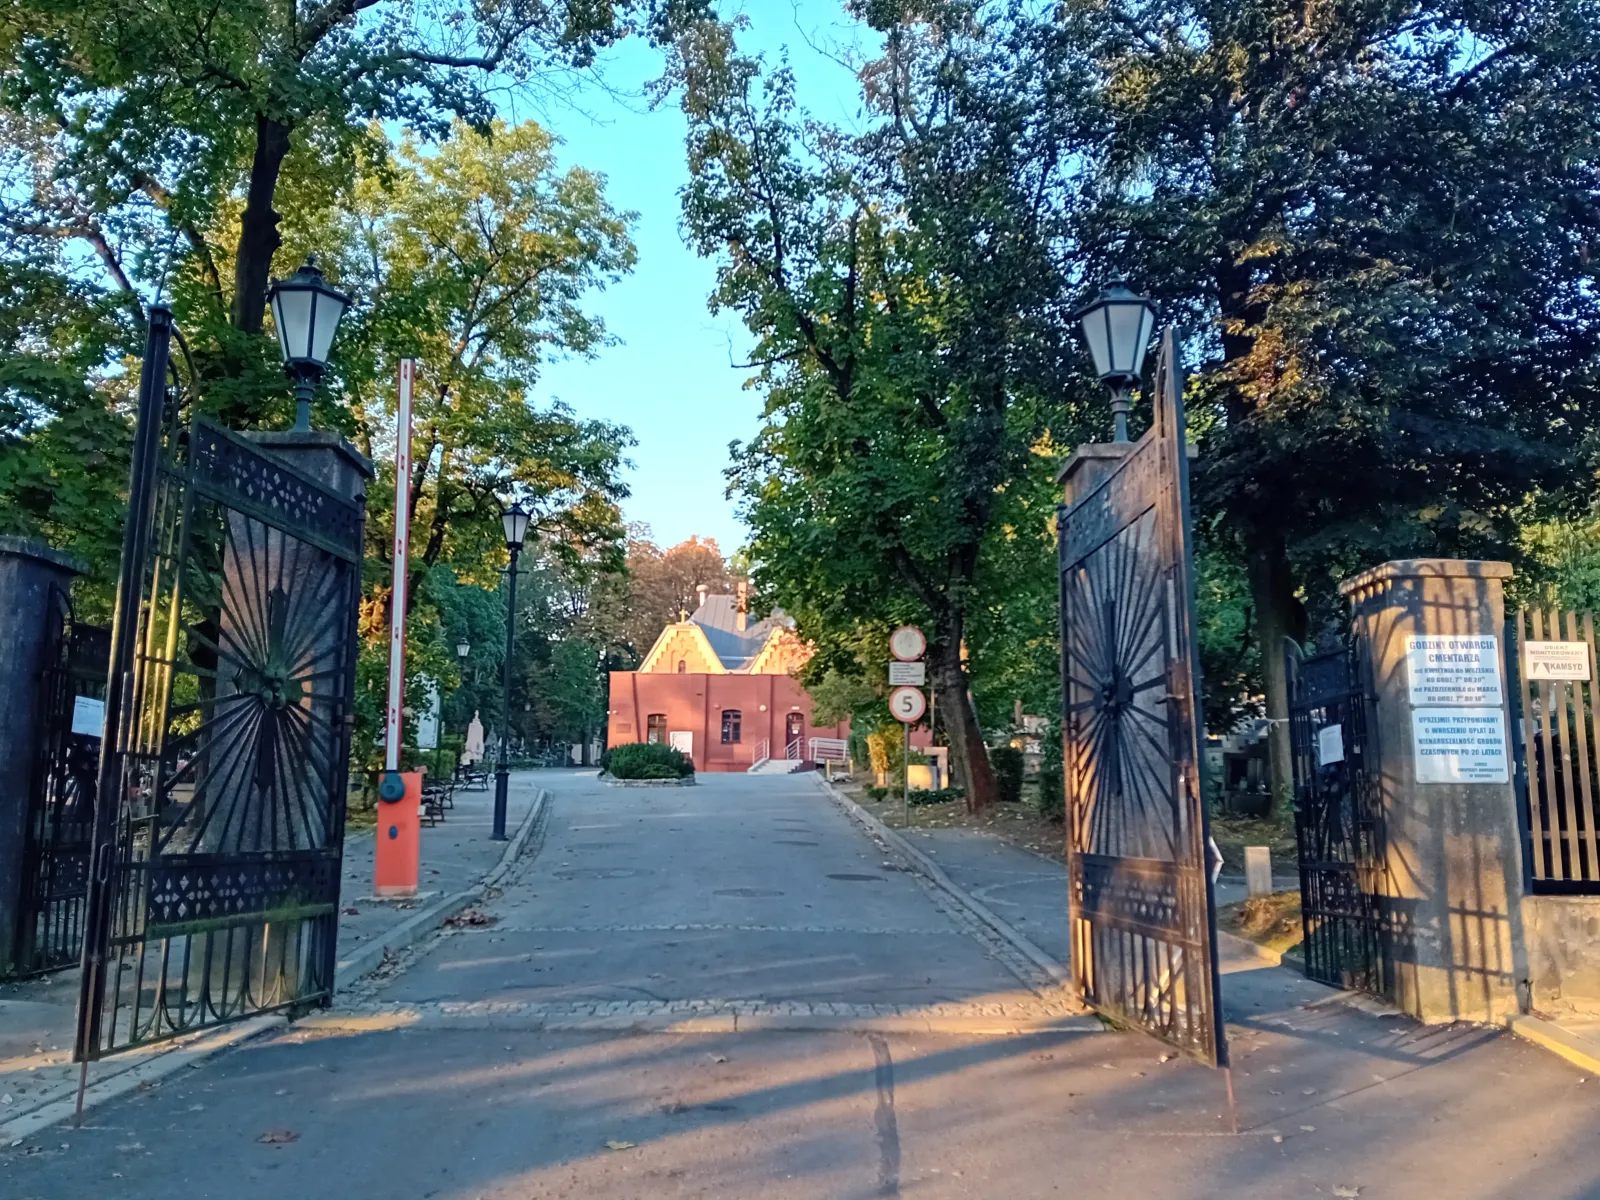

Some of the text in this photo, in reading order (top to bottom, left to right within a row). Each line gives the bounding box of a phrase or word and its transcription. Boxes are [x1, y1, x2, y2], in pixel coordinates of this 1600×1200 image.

[1410, 641, 1495, 649] GODZINY OTWARCIA
[1429, 654, 1480, 662] CMENTARZA
[902, 696, 912, 712] 5
